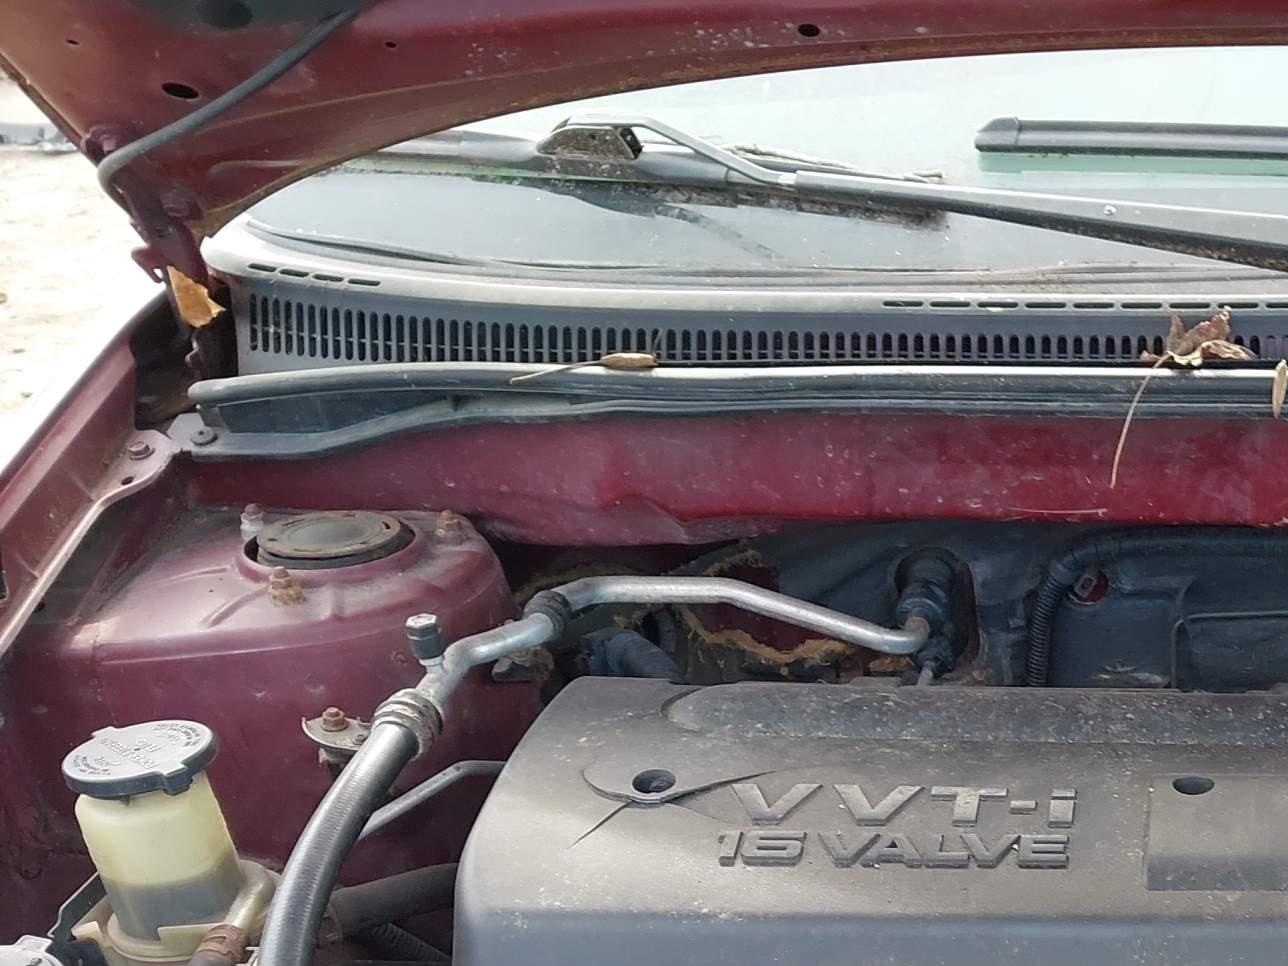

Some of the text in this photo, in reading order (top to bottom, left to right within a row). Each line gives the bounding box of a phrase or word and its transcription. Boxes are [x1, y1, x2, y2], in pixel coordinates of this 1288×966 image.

[732, 783, 1077, 828] VVT-i
[719, 831, 1070, 869] 16 VALVE
